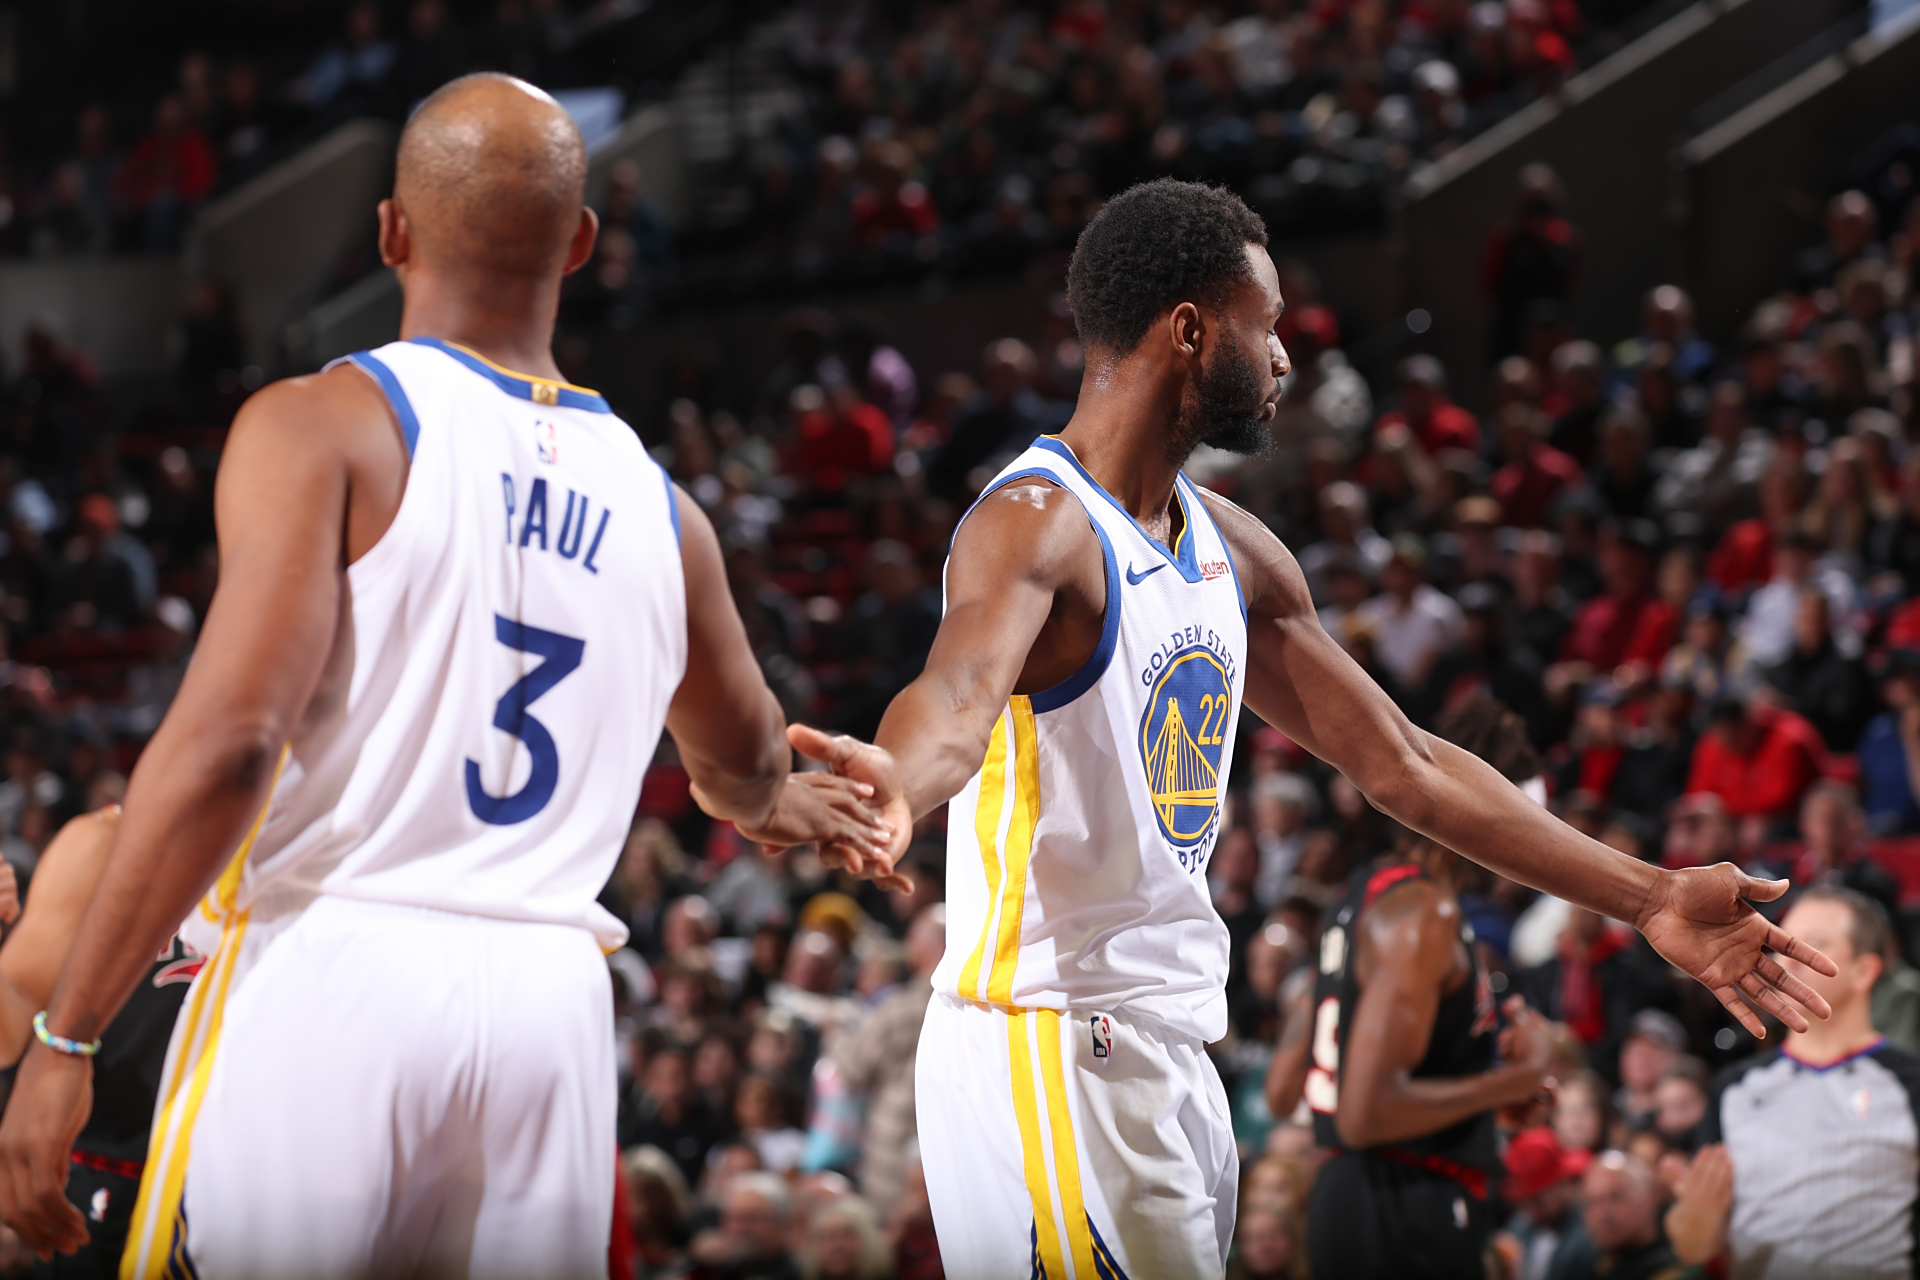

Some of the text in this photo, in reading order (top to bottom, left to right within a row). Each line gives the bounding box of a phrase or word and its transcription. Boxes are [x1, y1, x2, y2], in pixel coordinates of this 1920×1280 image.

[501, 472, 611, 574] PAUL
[1142, 624, 1236, 687] GOLDEN STATE
[465, 613, 586, 826] 3
[1198, 694, 1227, 745] 22
[1168, 802, 1219, 875] RIORS
